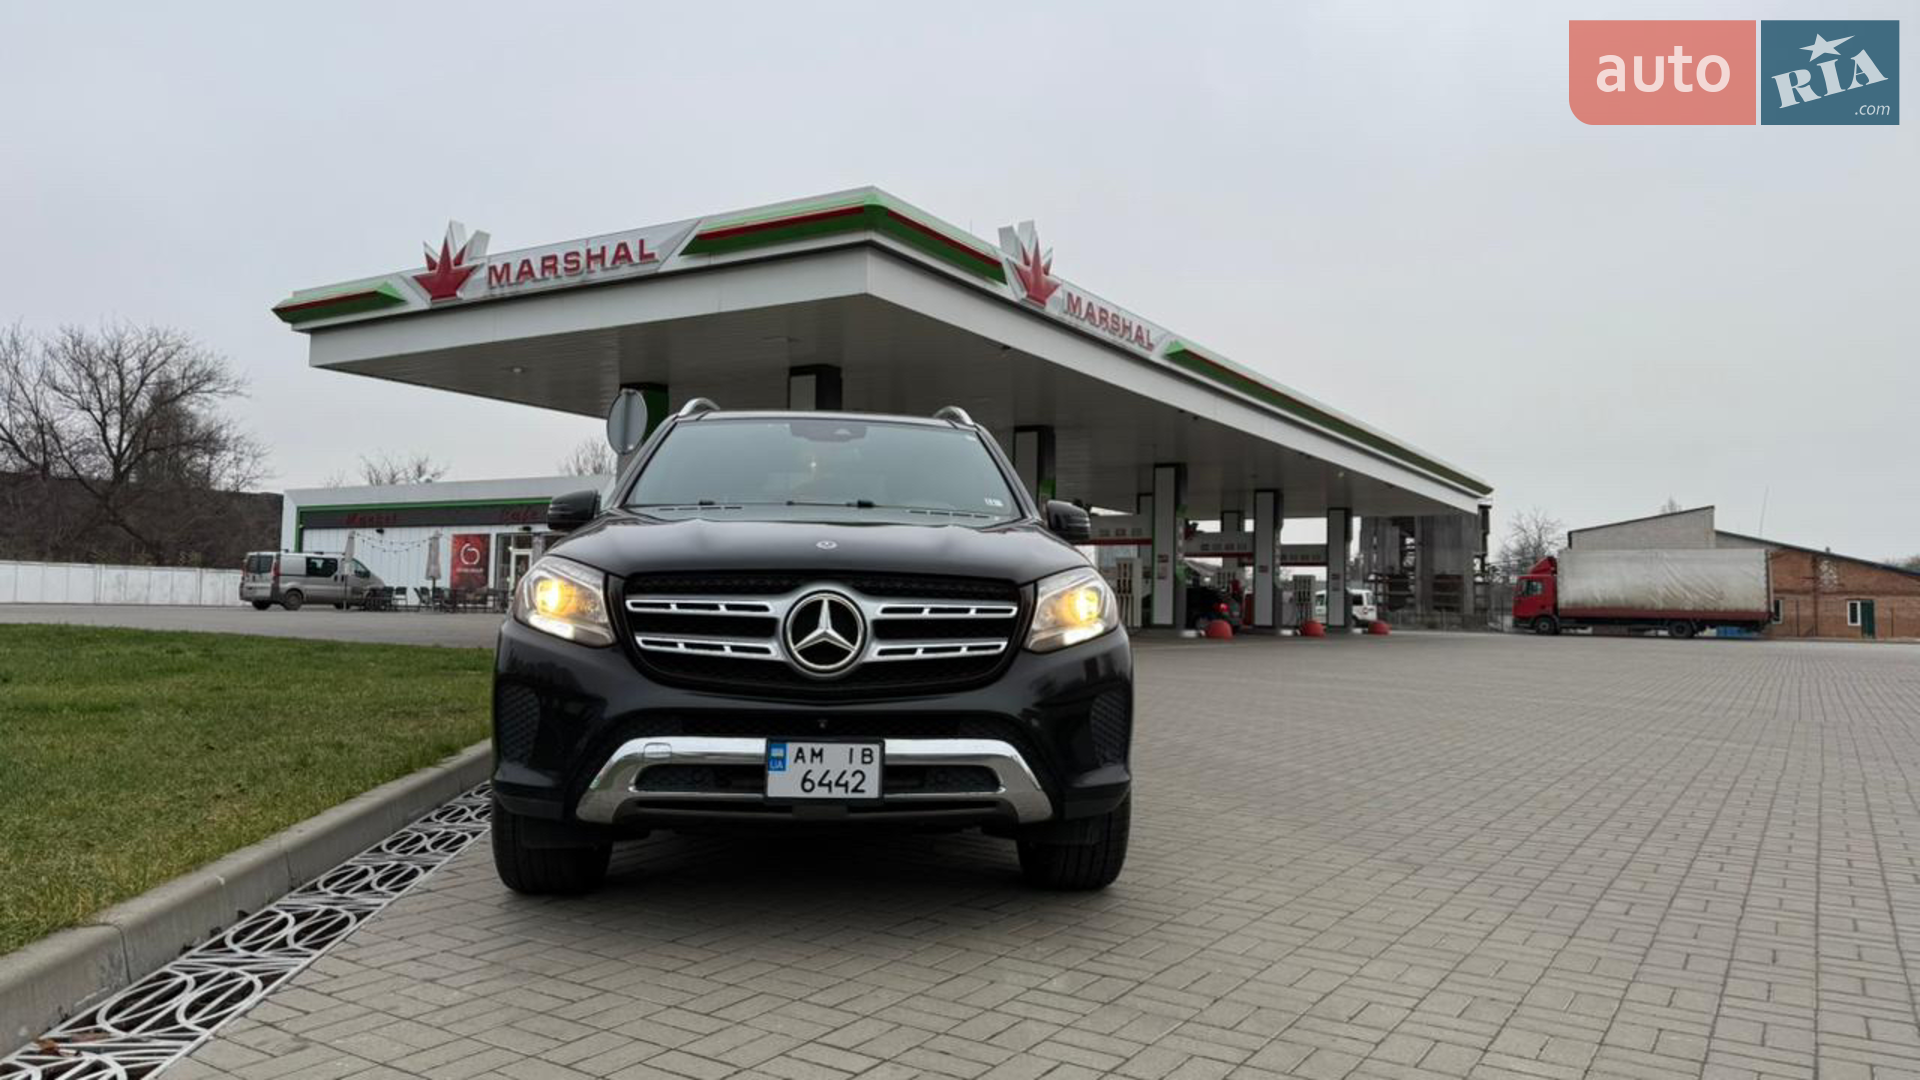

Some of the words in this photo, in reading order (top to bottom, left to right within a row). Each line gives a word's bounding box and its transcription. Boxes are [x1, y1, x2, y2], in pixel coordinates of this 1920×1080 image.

[487, 238, 659, 289] MARSHAL
[1066, 292, 1156, 352] MARSHAL
[794, 747, 824, 764] AM
[849, 748, 874, 765] IB
[800, 769, 866, 794] 6442
